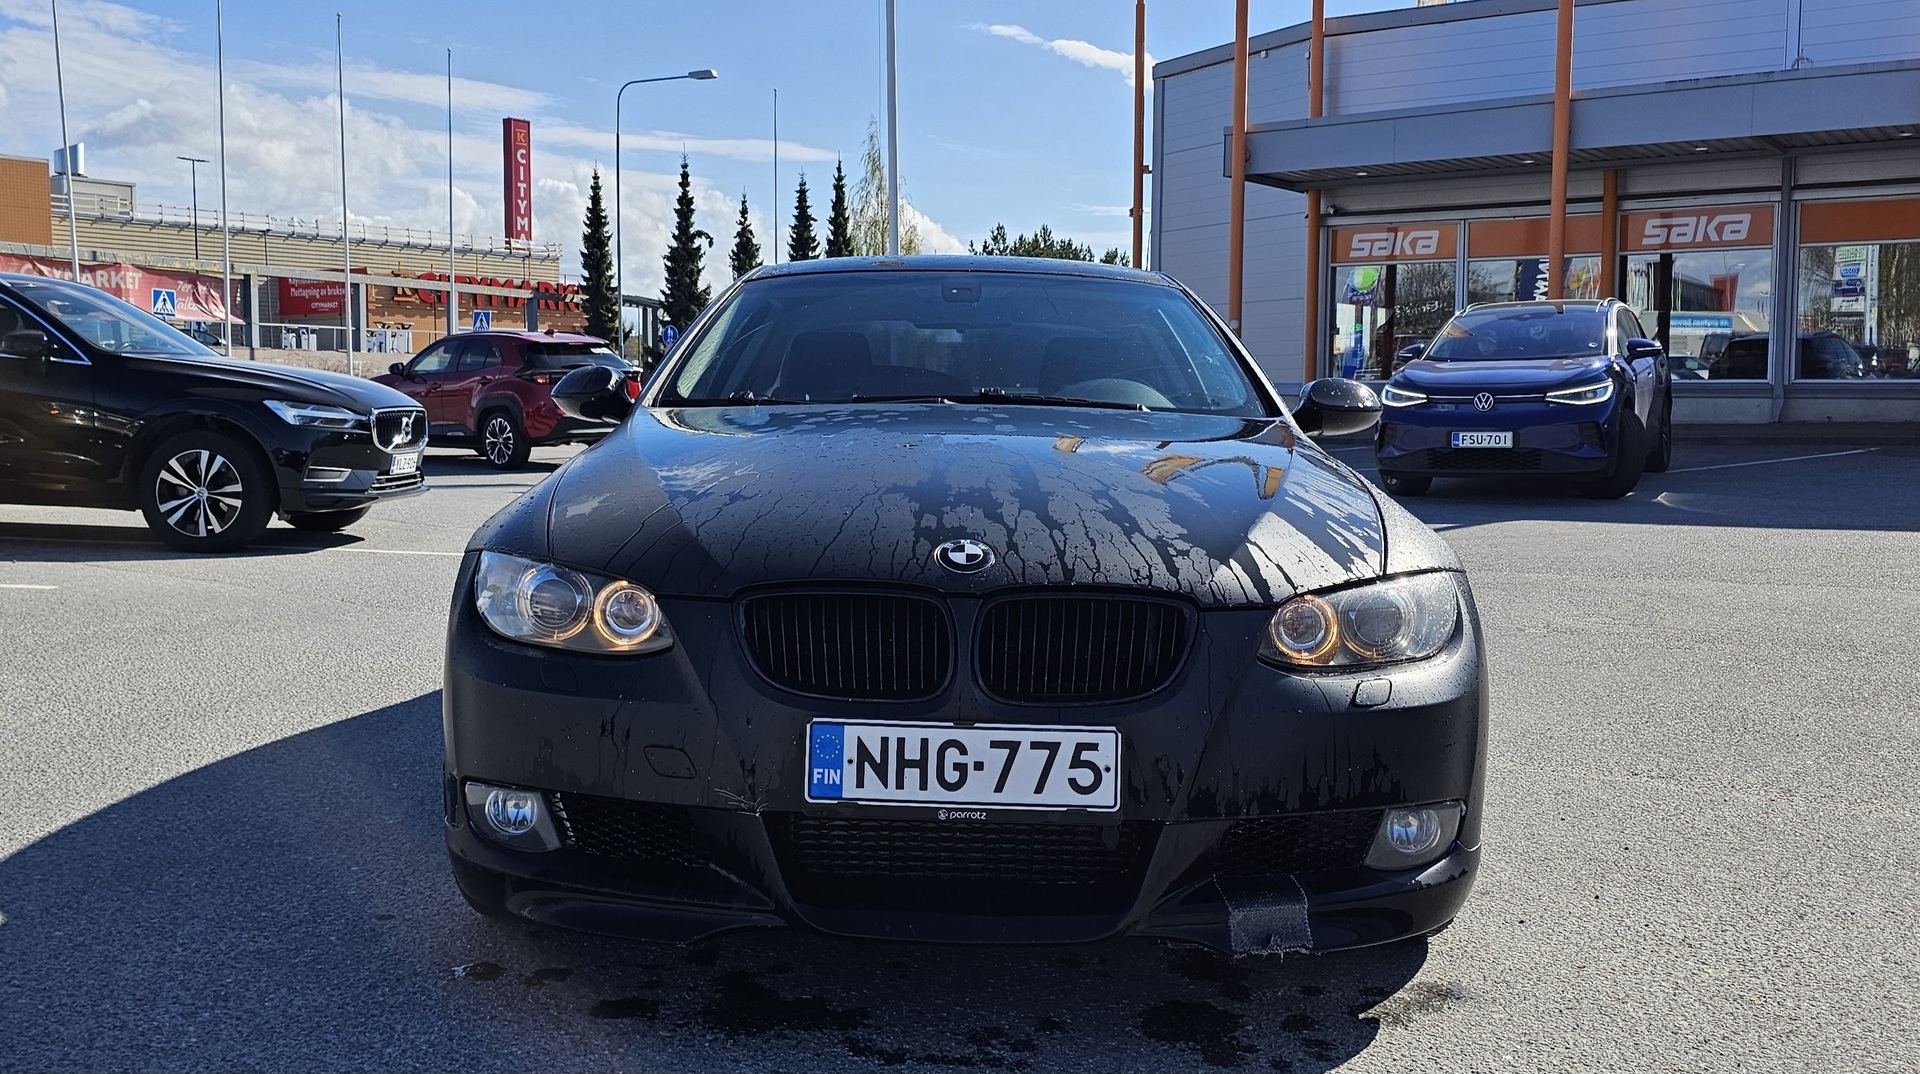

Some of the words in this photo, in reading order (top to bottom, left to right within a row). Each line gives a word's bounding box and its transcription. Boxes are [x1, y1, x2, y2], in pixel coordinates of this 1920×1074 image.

[417, 272, 582, 312] CITYMARK
[311, 301, 338, 309] CITYMARKET
[855, 735, 1103, 795] NHG-775
[813, 768, 841, 785] FIN
[950, 811, 987, 820] parrotz
